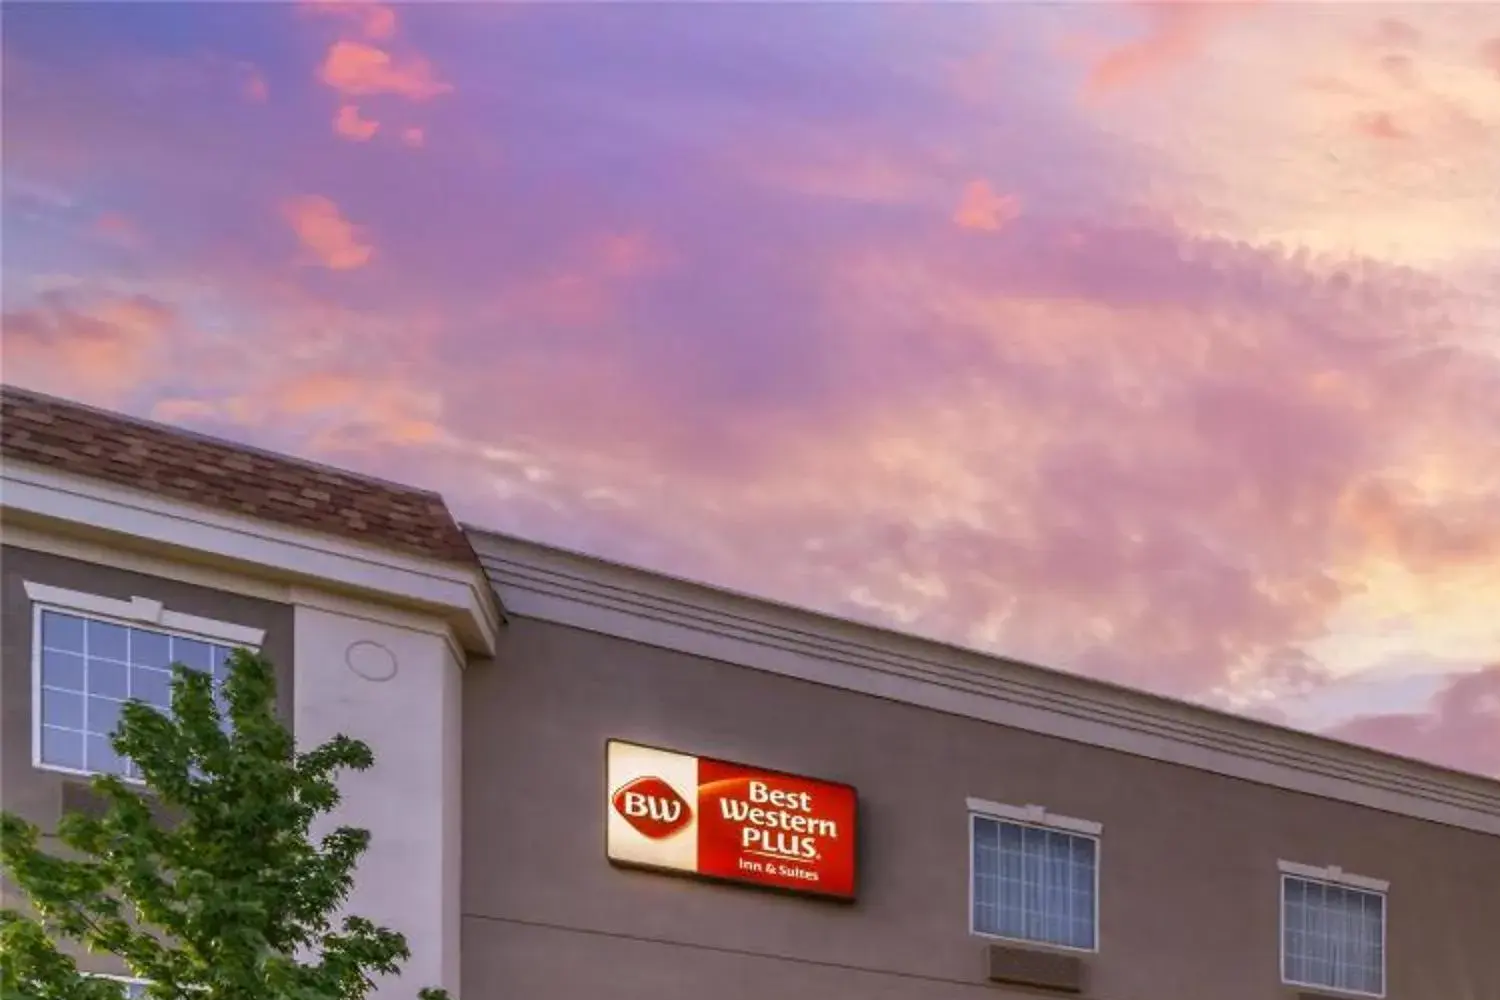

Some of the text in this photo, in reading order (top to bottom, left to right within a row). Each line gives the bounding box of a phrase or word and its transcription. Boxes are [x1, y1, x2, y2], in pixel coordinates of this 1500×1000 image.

[624, 791, 681, 823] BW
[749, 780, 812, 812] Best
[720, 797, 837, 838] Western
[742, 827, 816, 858] PLUS
[739, 857, 819, 881] Inn & Suites
